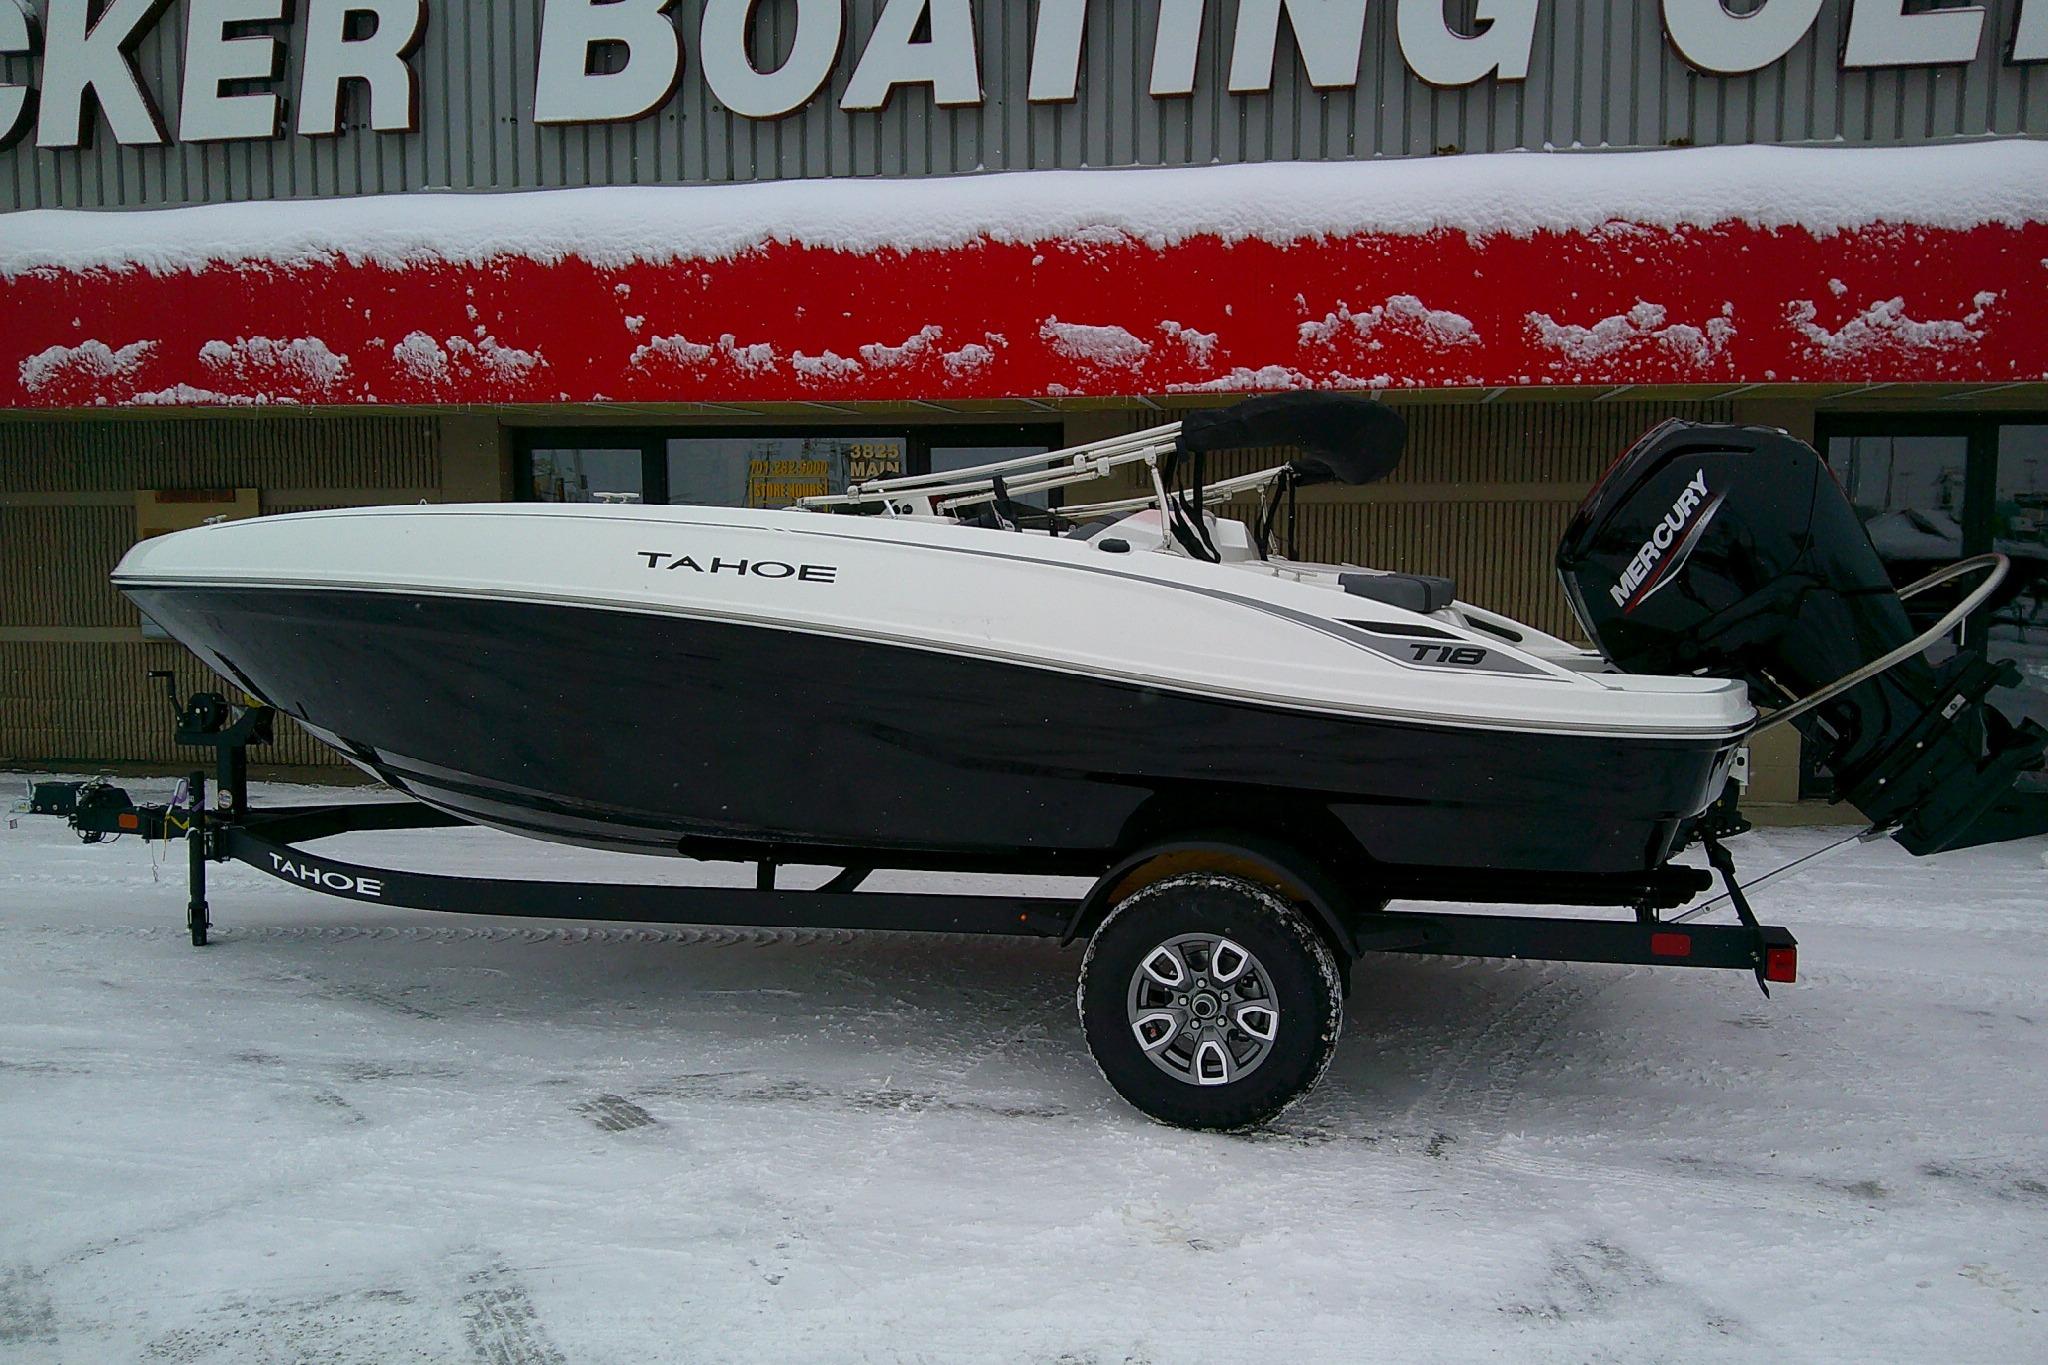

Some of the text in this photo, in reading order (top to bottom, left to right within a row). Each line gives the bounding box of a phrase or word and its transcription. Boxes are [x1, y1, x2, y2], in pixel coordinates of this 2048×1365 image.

[850, 445, 899, 459] 3825
[850, 461, 899, 477] MAIN
[754, 482, 785, 497] STORE
[1609, 468, 1708, 607] MERCURY
[637, 551, 837, 583] TAHOE
[1409, 643, 1487, 665] T18
[269, 852, 381, 896] TAHOE
